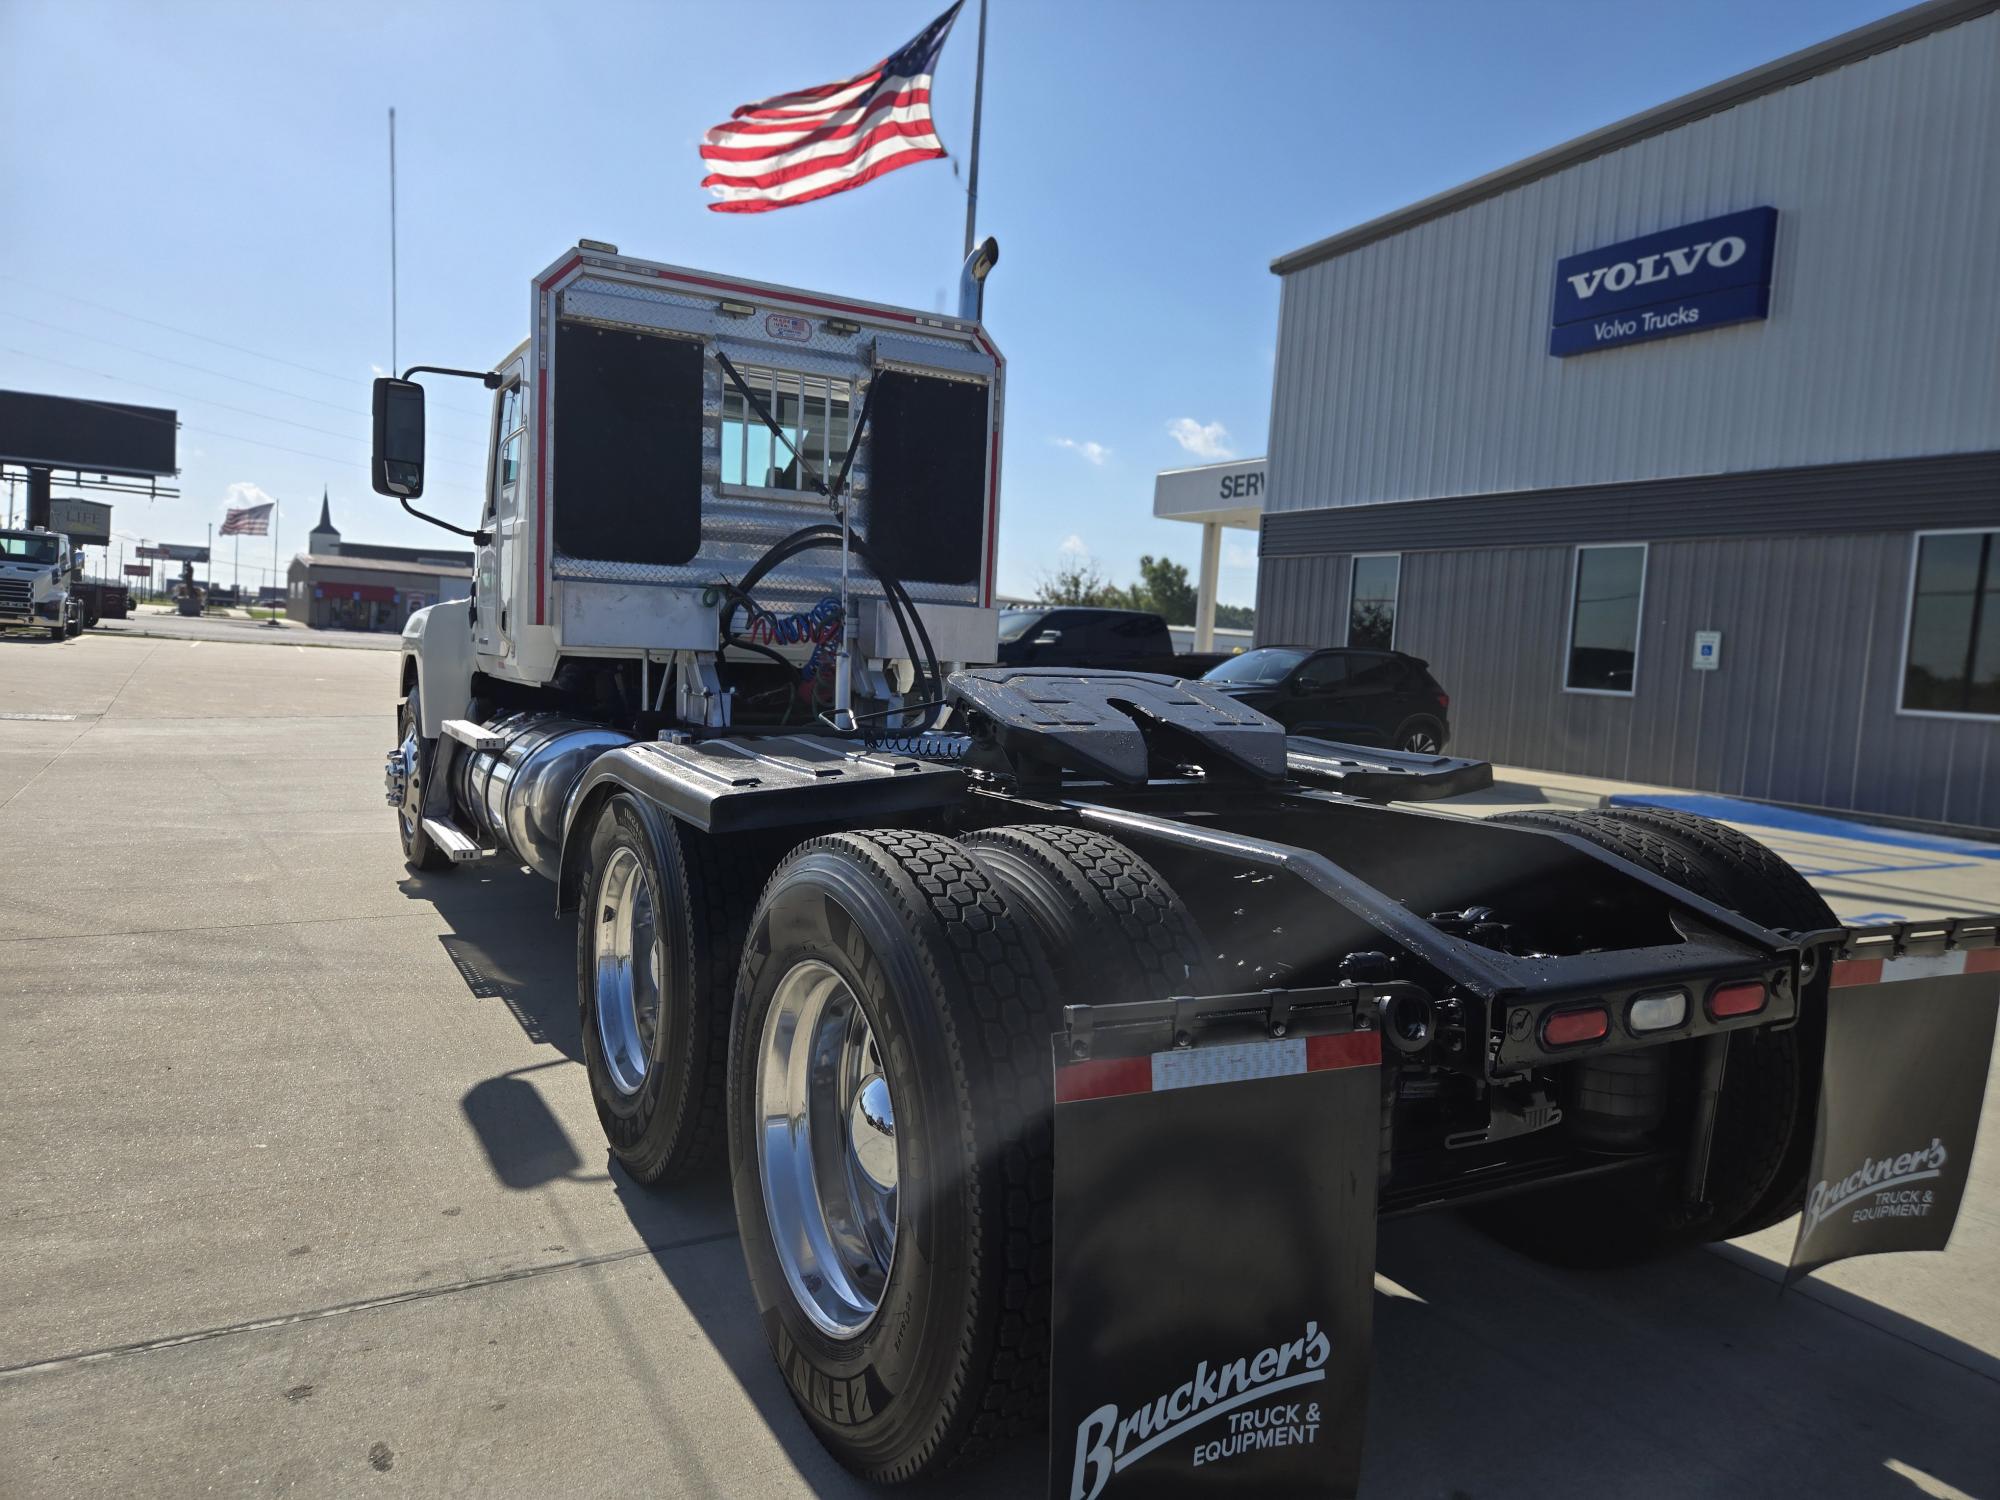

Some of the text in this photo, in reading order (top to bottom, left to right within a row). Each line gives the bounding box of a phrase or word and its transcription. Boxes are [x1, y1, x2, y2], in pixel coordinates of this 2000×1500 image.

[1567, 236, 1747, 299] VOLVO
[1594, 306, 1700, 341] Volvo Trucks
[1800, 1137, 1948, 1243] Bruckner's
[1875, 1190, 1934, 1206] TRUCK &
[1852, 1203, 1931, 1223] EQUIPMENT
[1070, 1321, 1331, 1500] Bruckner's
[1228, 1402, 1321, 1434] TRUCK &
[1193, 1424, 1320, 1467] EQUIPMENT
